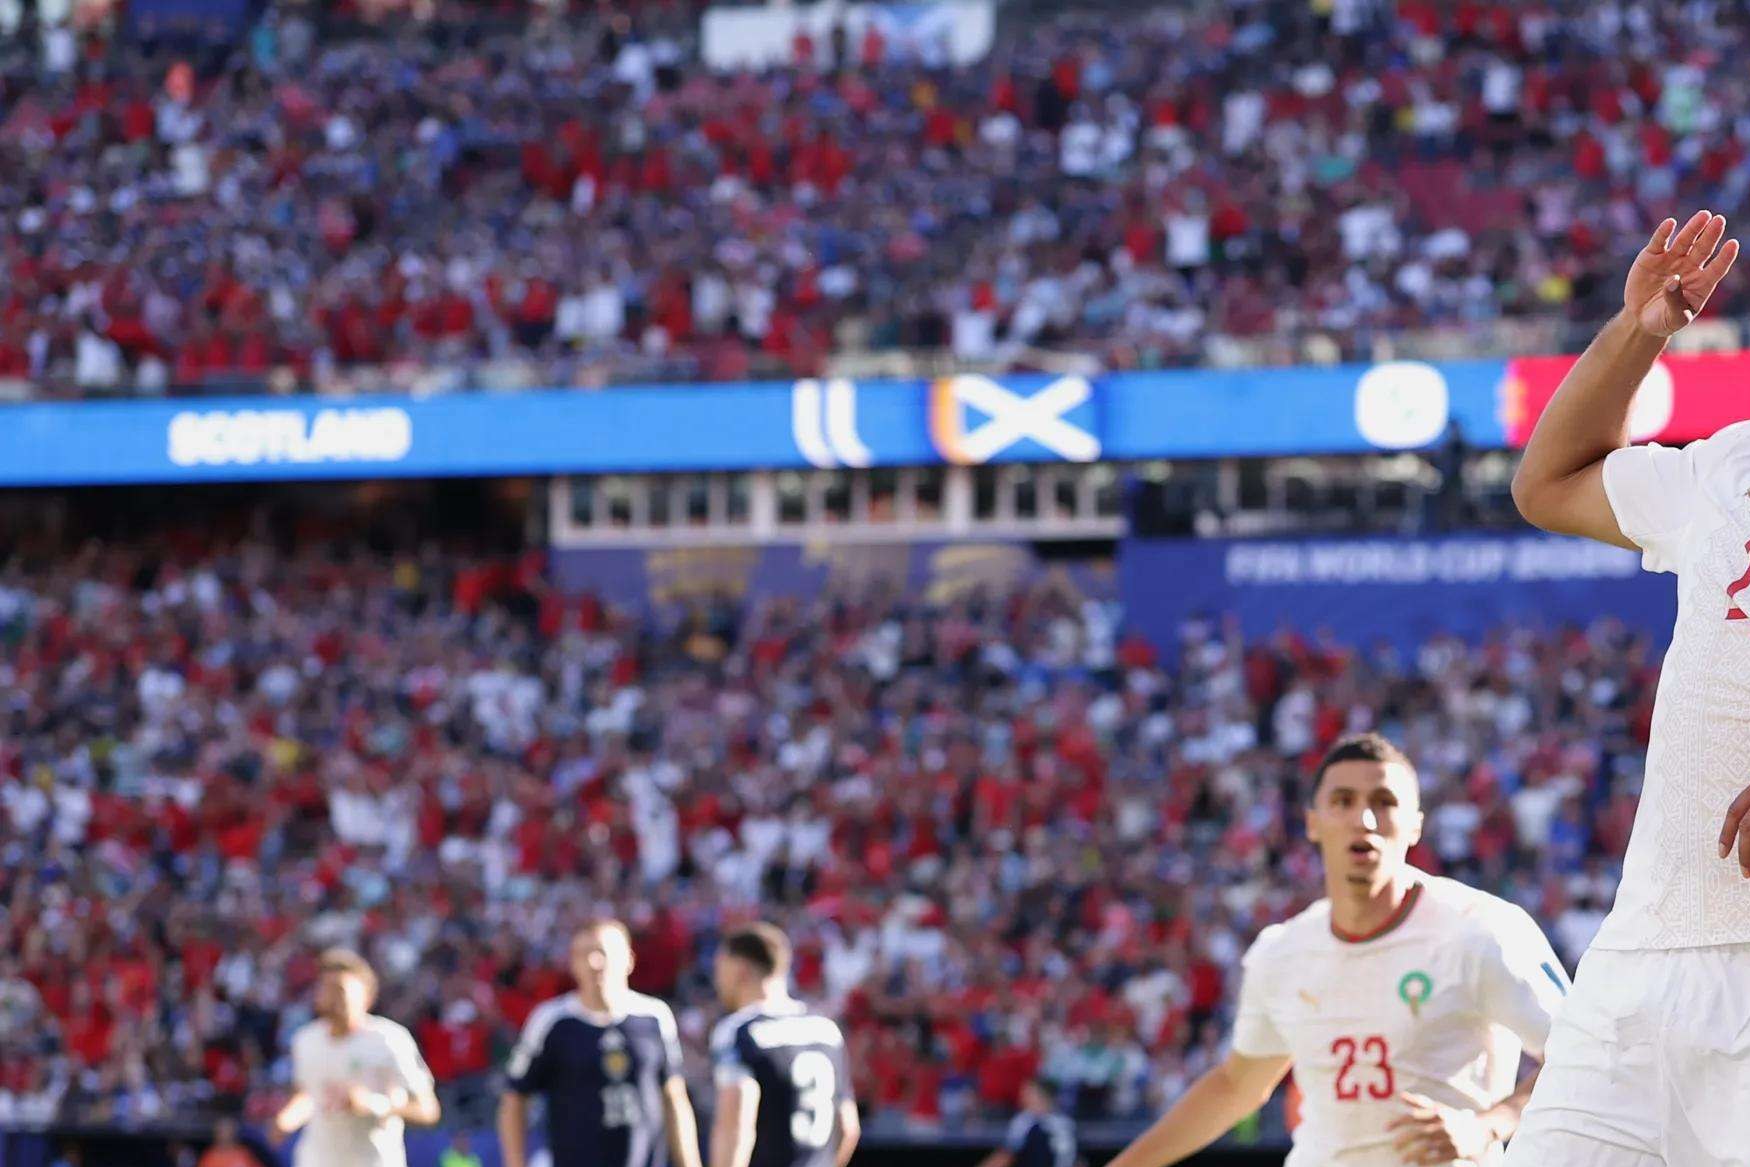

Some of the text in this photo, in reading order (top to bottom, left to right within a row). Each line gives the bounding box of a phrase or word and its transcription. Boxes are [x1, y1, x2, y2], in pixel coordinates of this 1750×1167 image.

[169, 408, 411, 465] SCOTLAND
[790, 1050, 835, 1147] 3
[1330, 1036, 1396, 1101] 23
